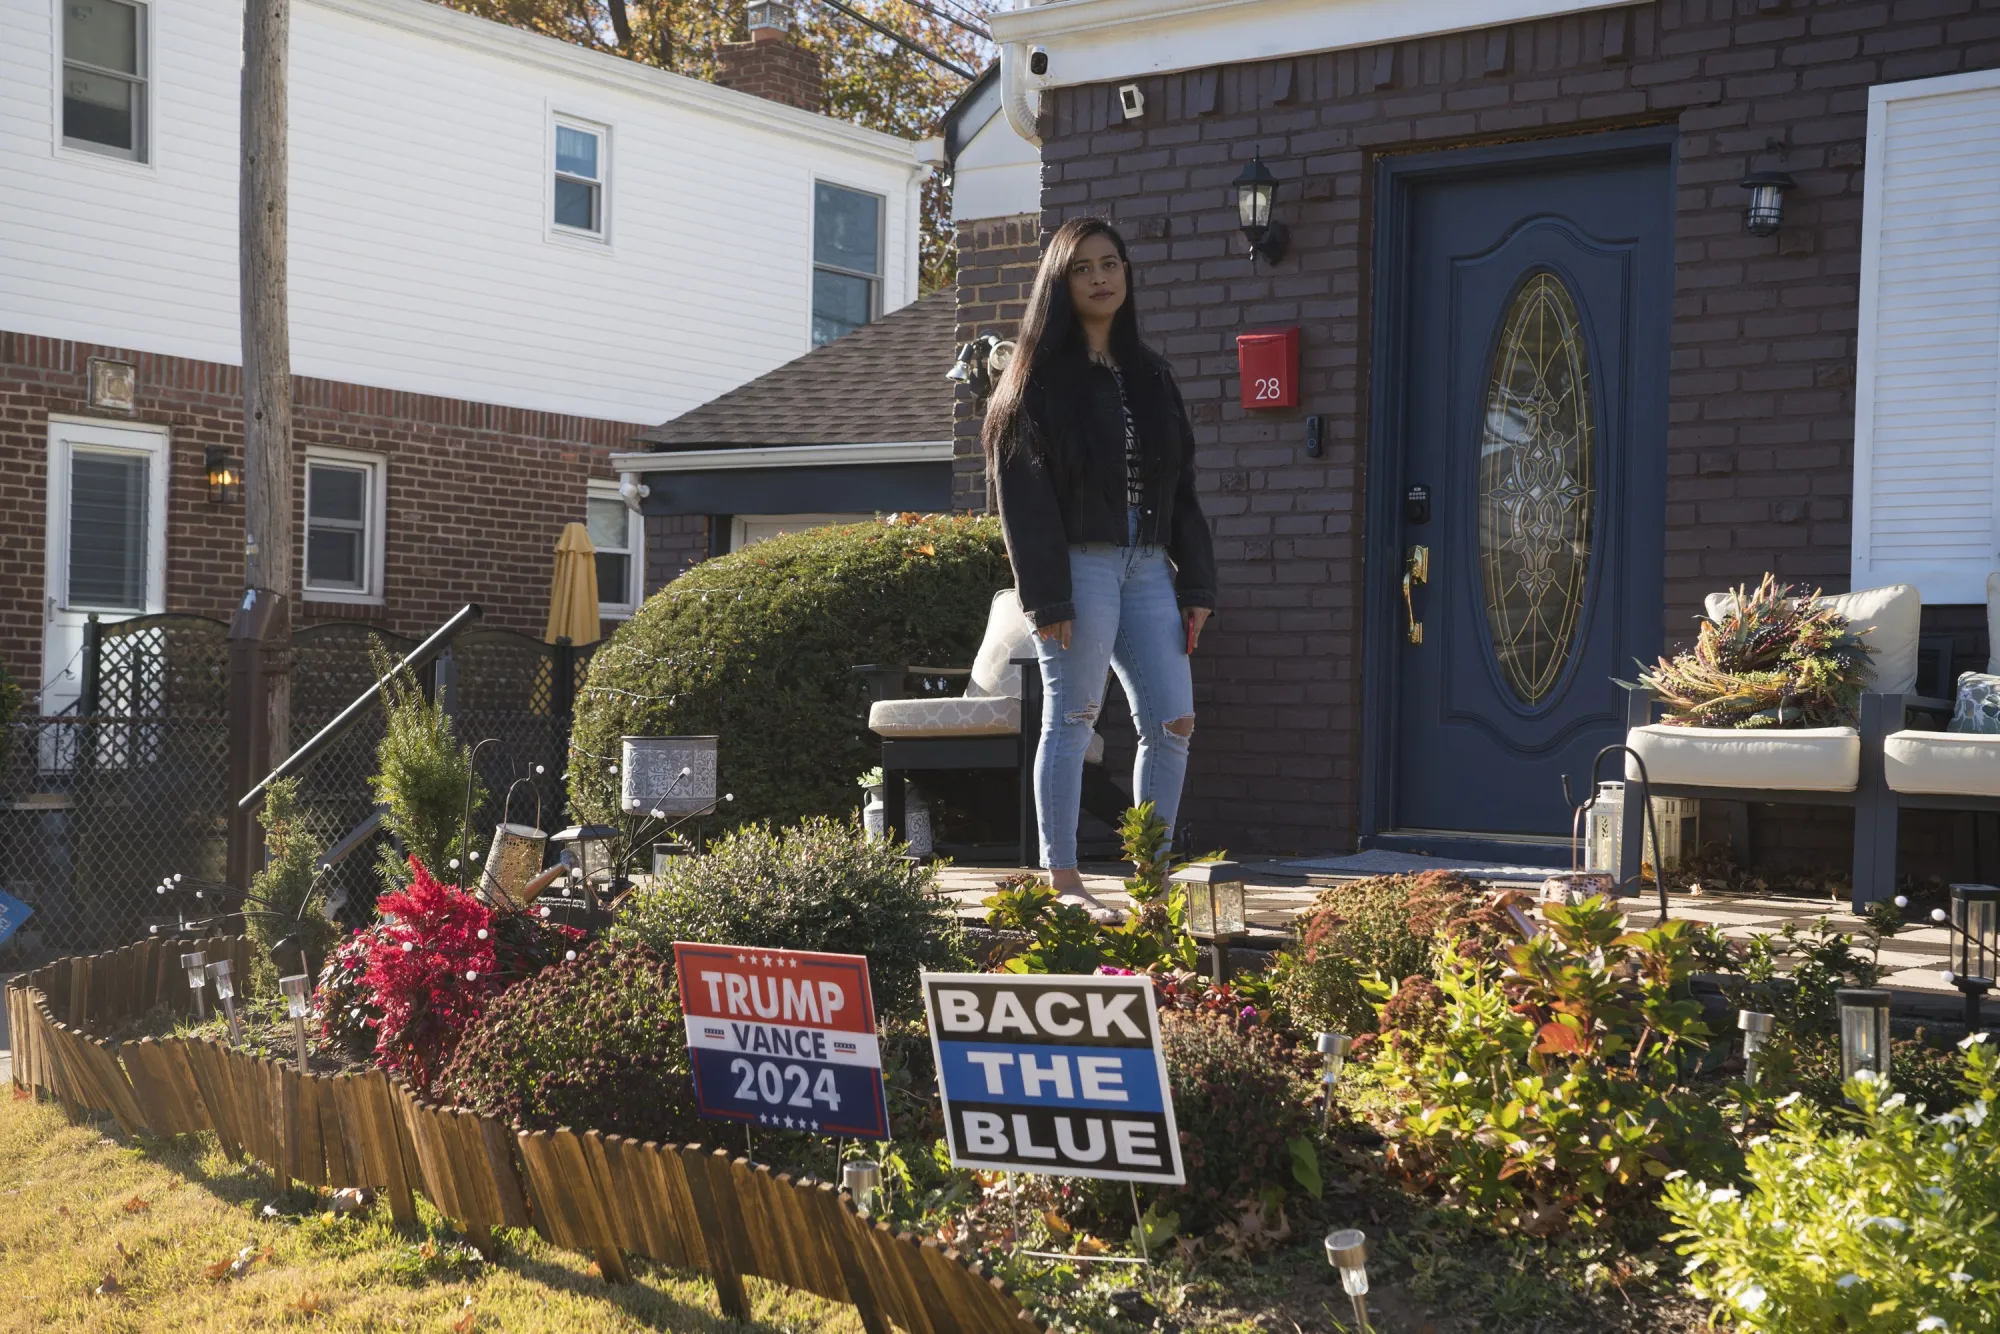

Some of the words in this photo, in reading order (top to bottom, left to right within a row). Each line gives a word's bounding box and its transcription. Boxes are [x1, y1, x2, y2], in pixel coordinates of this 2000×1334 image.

[1254, 377, 1281, 400] 28
[700, 970, 845, 1025] TRUMP
[937, 989, 1146, 1039] BACK
[731, 1022, 828, 1060] VANCE
[730, 1057, 841, 1112] 2024
[966, 1051, 1129, 1102] THE
[961, 1110, 1162, 1167] BLUE
